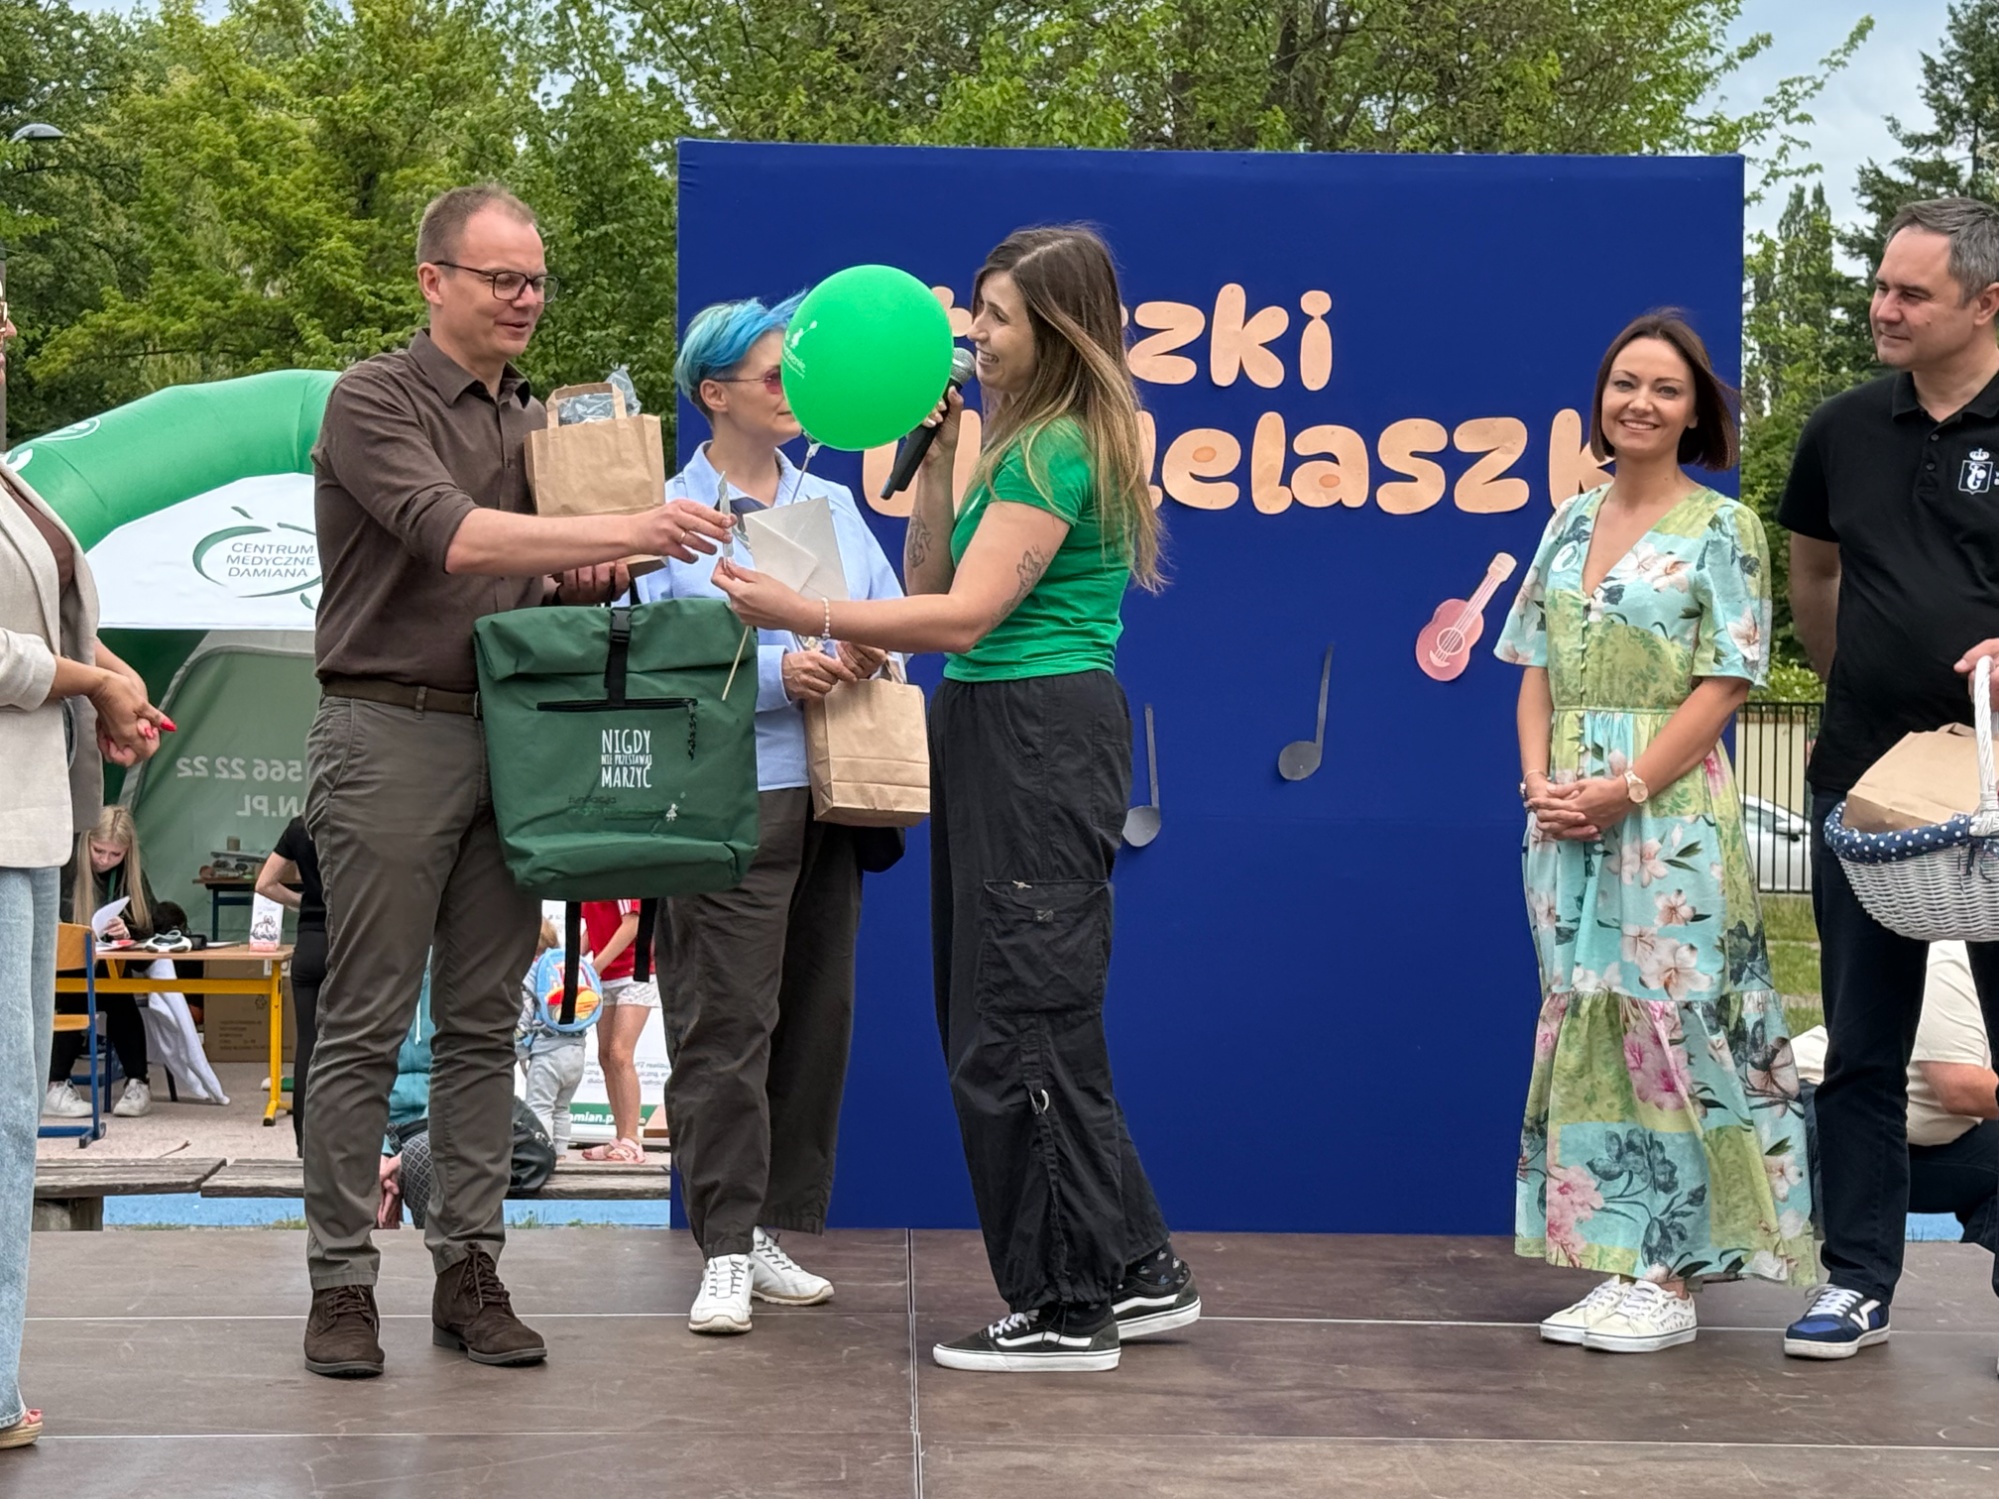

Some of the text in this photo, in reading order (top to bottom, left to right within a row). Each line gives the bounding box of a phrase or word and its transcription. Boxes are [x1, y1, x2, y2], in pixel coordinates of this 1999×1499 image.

[231, 542, 315, 555] CENTRUM
[226, 554, 316, 566] MEDYCZNE
[228, 567, 309, 578] DAMIANA
[601, 729, 651, 754] NIGDY
